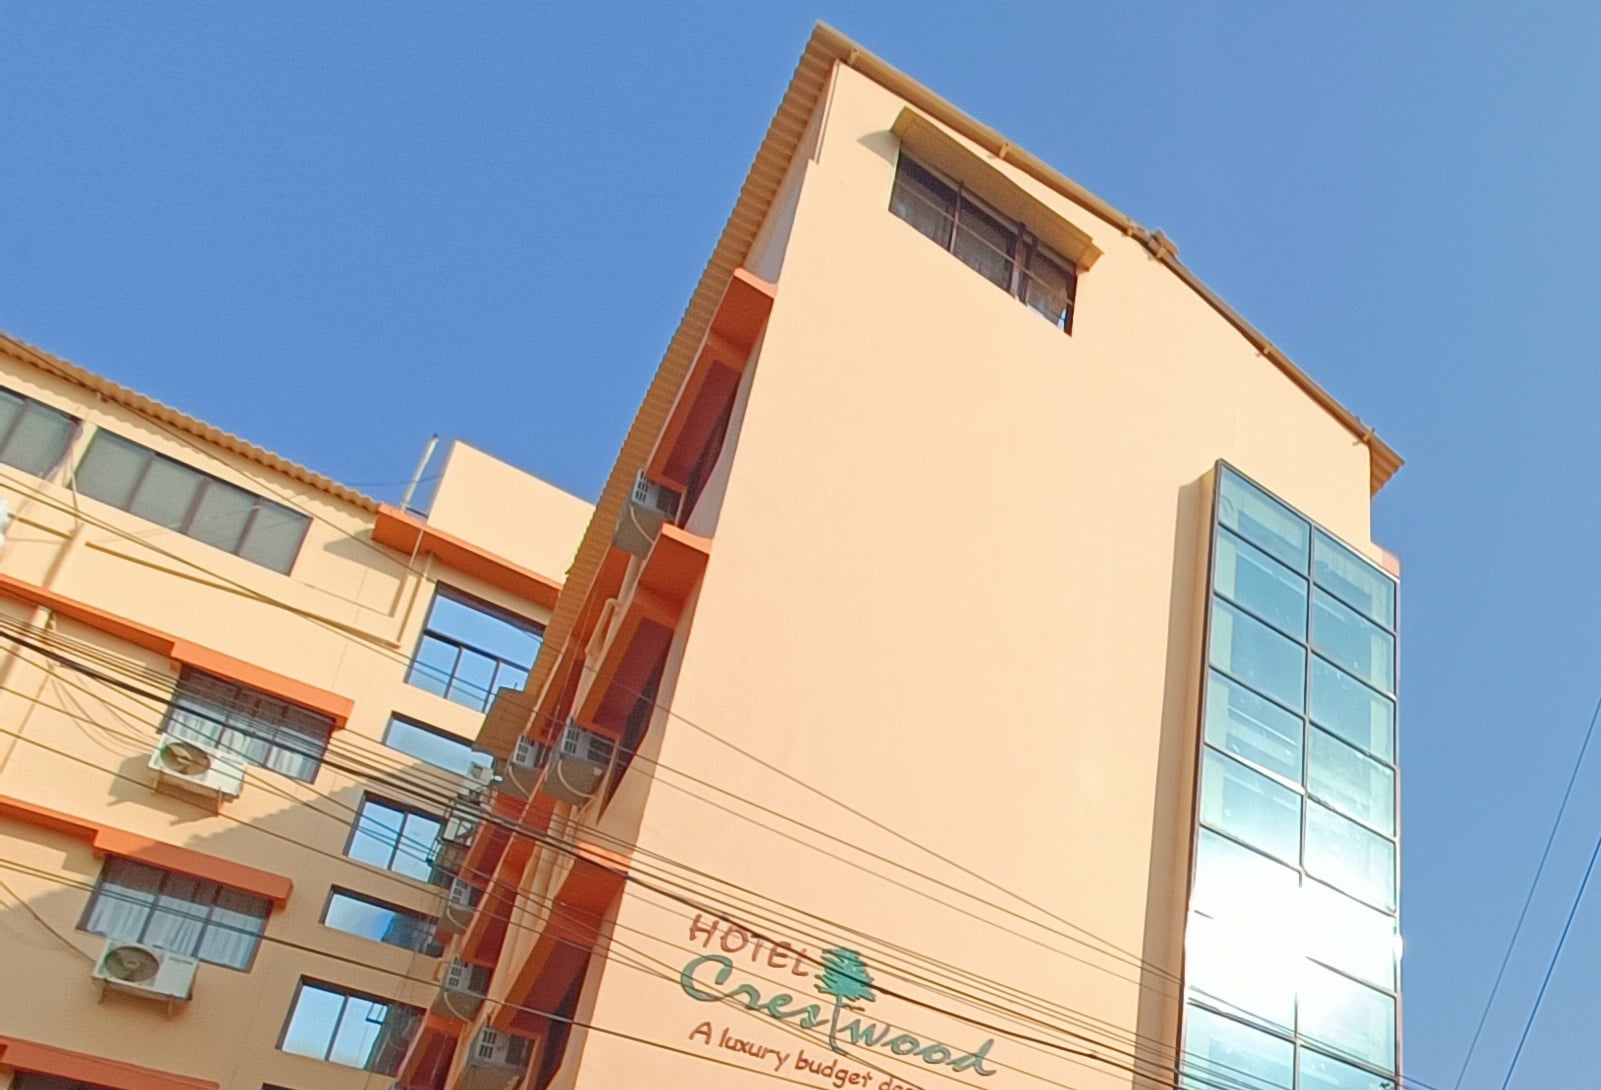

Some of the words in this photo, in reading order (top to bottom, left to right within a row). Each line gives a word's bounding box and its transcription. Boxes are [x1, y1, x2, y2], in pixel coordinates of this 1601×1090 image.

[689, 914, 809, 976] HOTEL
[680, 954, 997, 1076] Crestwood
[688, 1021, 713, 1045] A
[718, 1027, 791, 1072] luxury
[794, 1049, 873, 1089] budget
